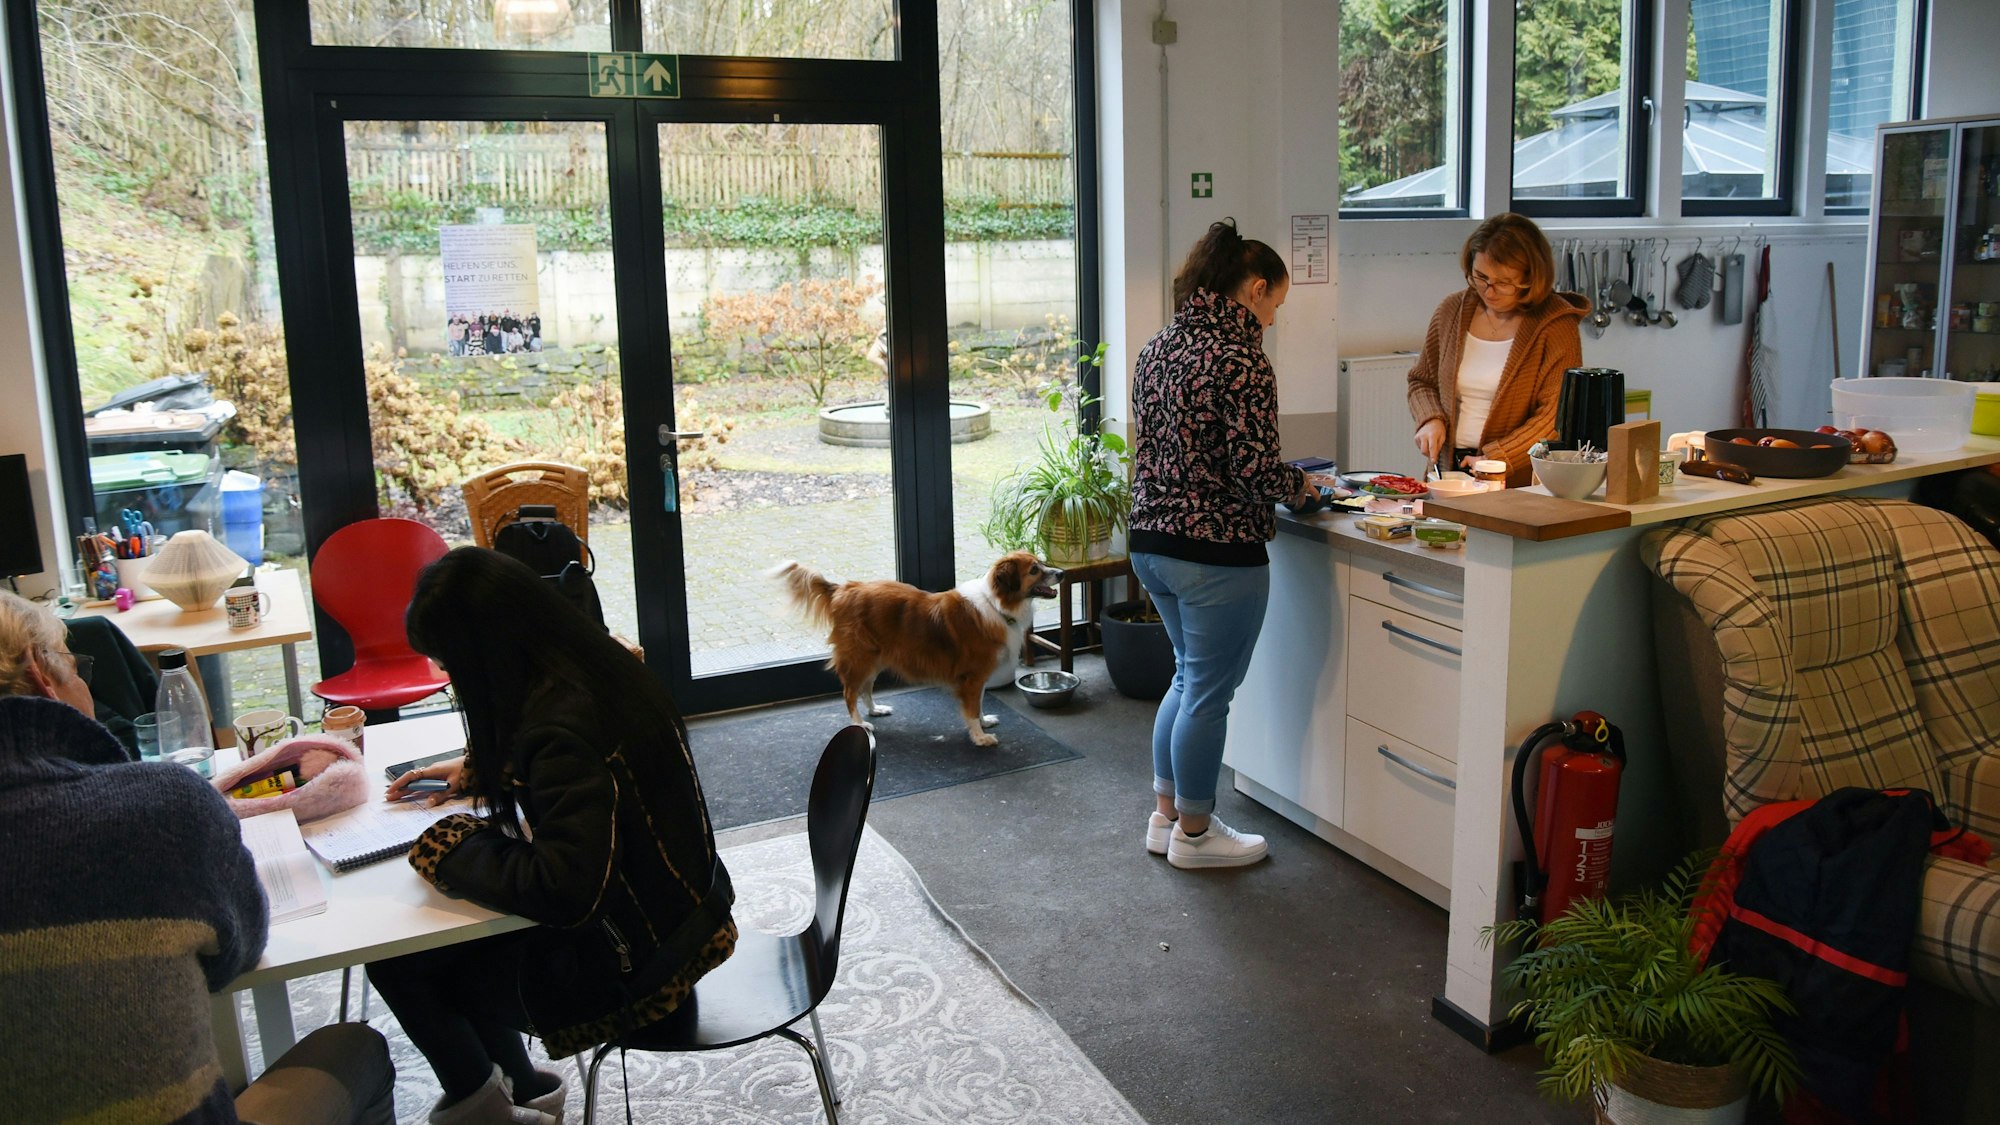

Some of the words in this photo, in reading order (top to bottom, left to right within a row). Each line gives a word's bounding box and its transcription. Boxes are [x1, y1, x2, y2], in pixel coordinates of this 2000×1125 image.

[444, 262, 479, 270] HELFEN
[481, 261, 495, 269] SIE
[445, 275, 476, 283] START
[478, 274, 490, 282] ZU
[492, 273, 528, 282] RETTEN
[1580, 841, 1587, 854] 1
[1576, 854, 1587, 868] 2
[1575, 868, 1585, 882] 3
